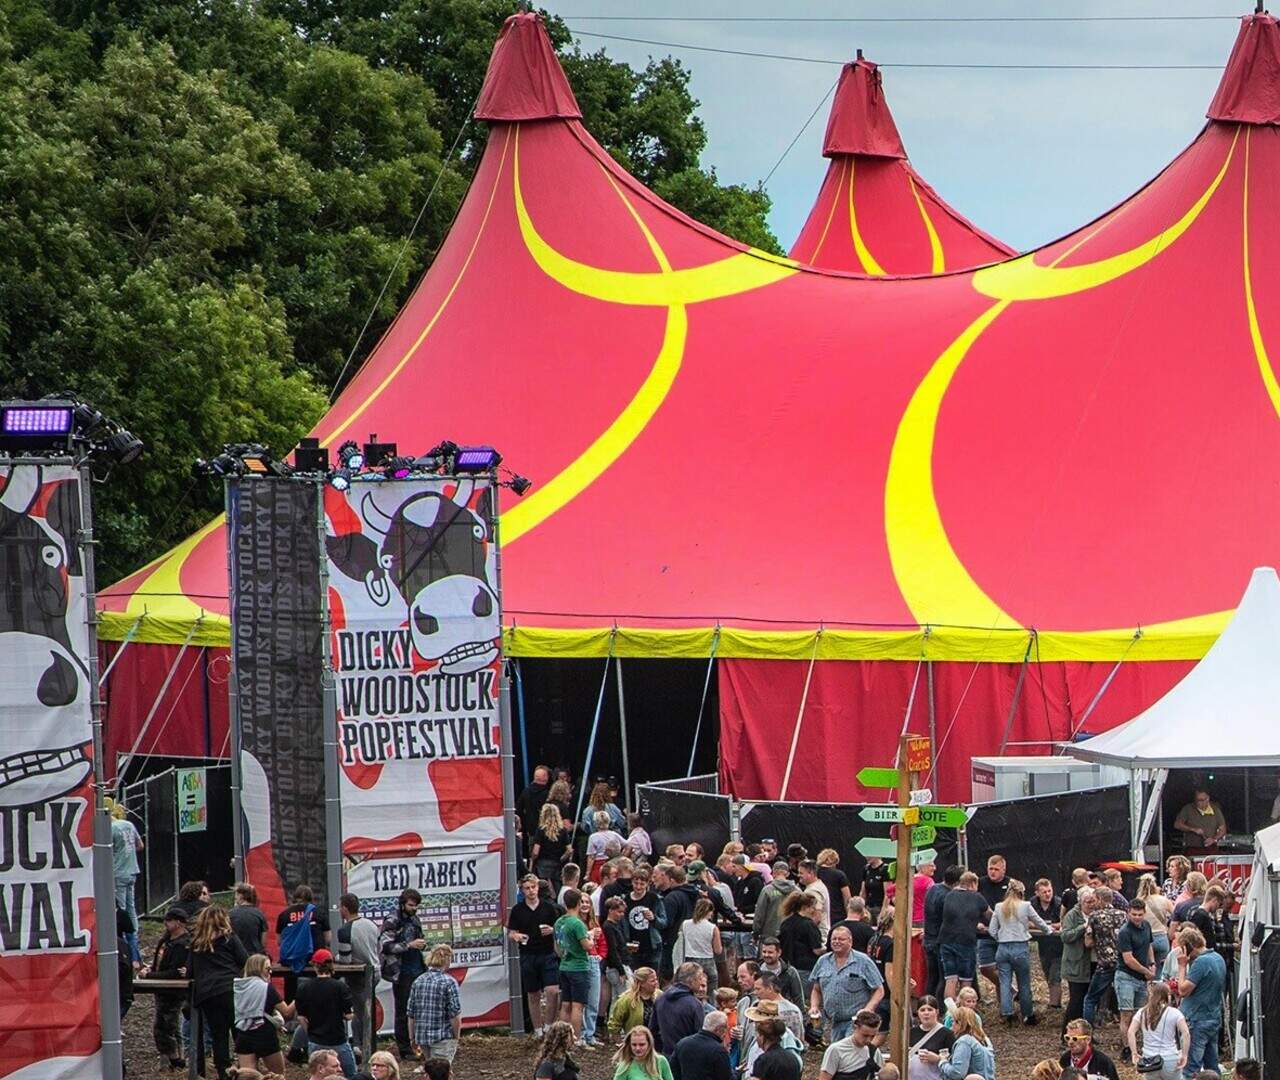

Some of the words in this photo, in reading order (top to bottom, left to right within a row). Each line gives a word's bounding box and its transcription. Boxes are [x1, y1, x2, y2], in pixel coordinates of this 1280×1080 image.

[339, 630, 412, 671] DICKY
[341, 670, 494, 717] WOODSTOCK
[874, 811, 898, 820] BIER
[372, 864, 410, 891] TIED
[415, 859, 477, 889] TABELS
